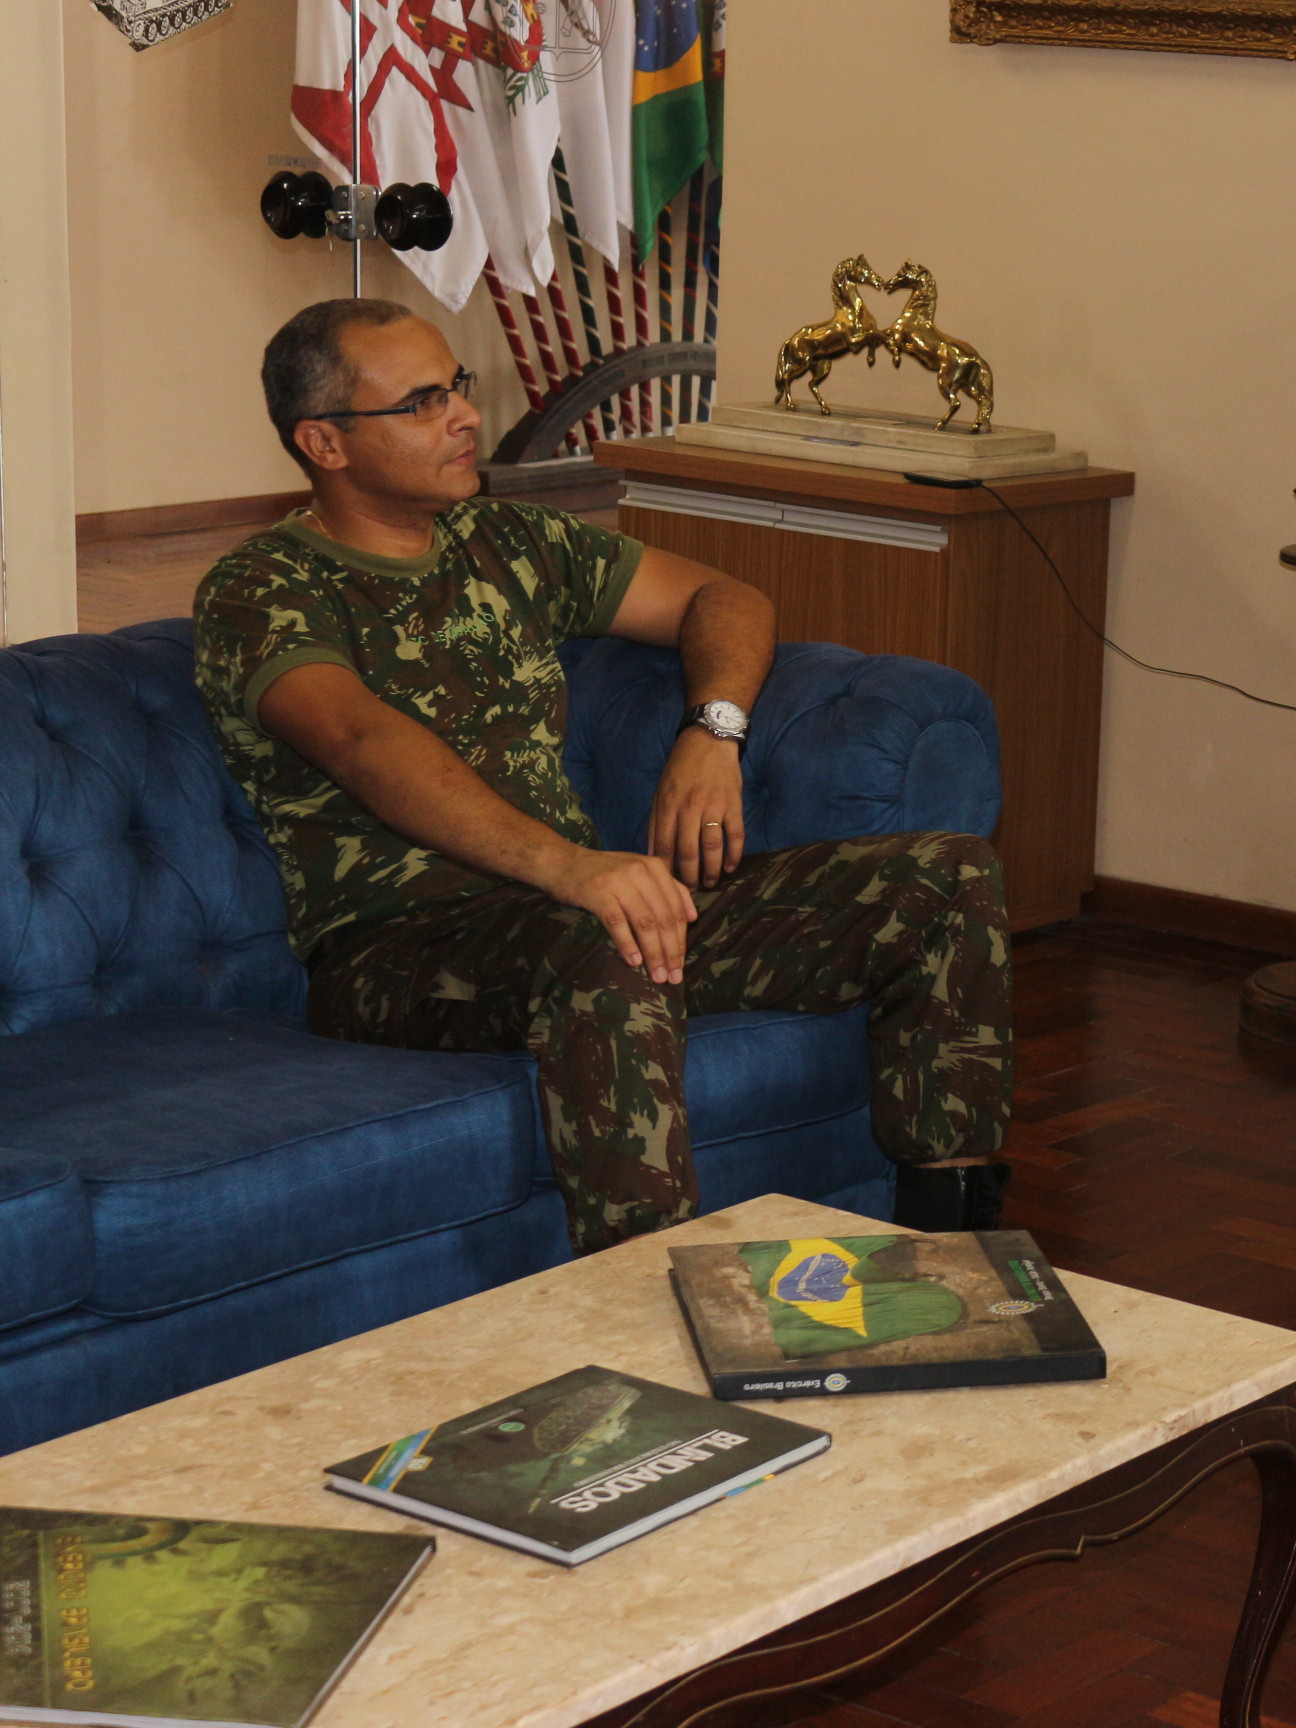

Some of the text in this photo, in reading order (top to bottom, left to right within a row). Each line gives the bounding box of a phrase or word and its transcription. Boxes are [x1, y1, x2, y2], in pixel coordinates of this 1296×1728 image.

[743, 1379, 821, 1392] Exército Brasileiro
[558, 1430, 750, 1513] BLINDADOS
[60, 1607, 94, 1691] BRASILEIRO
